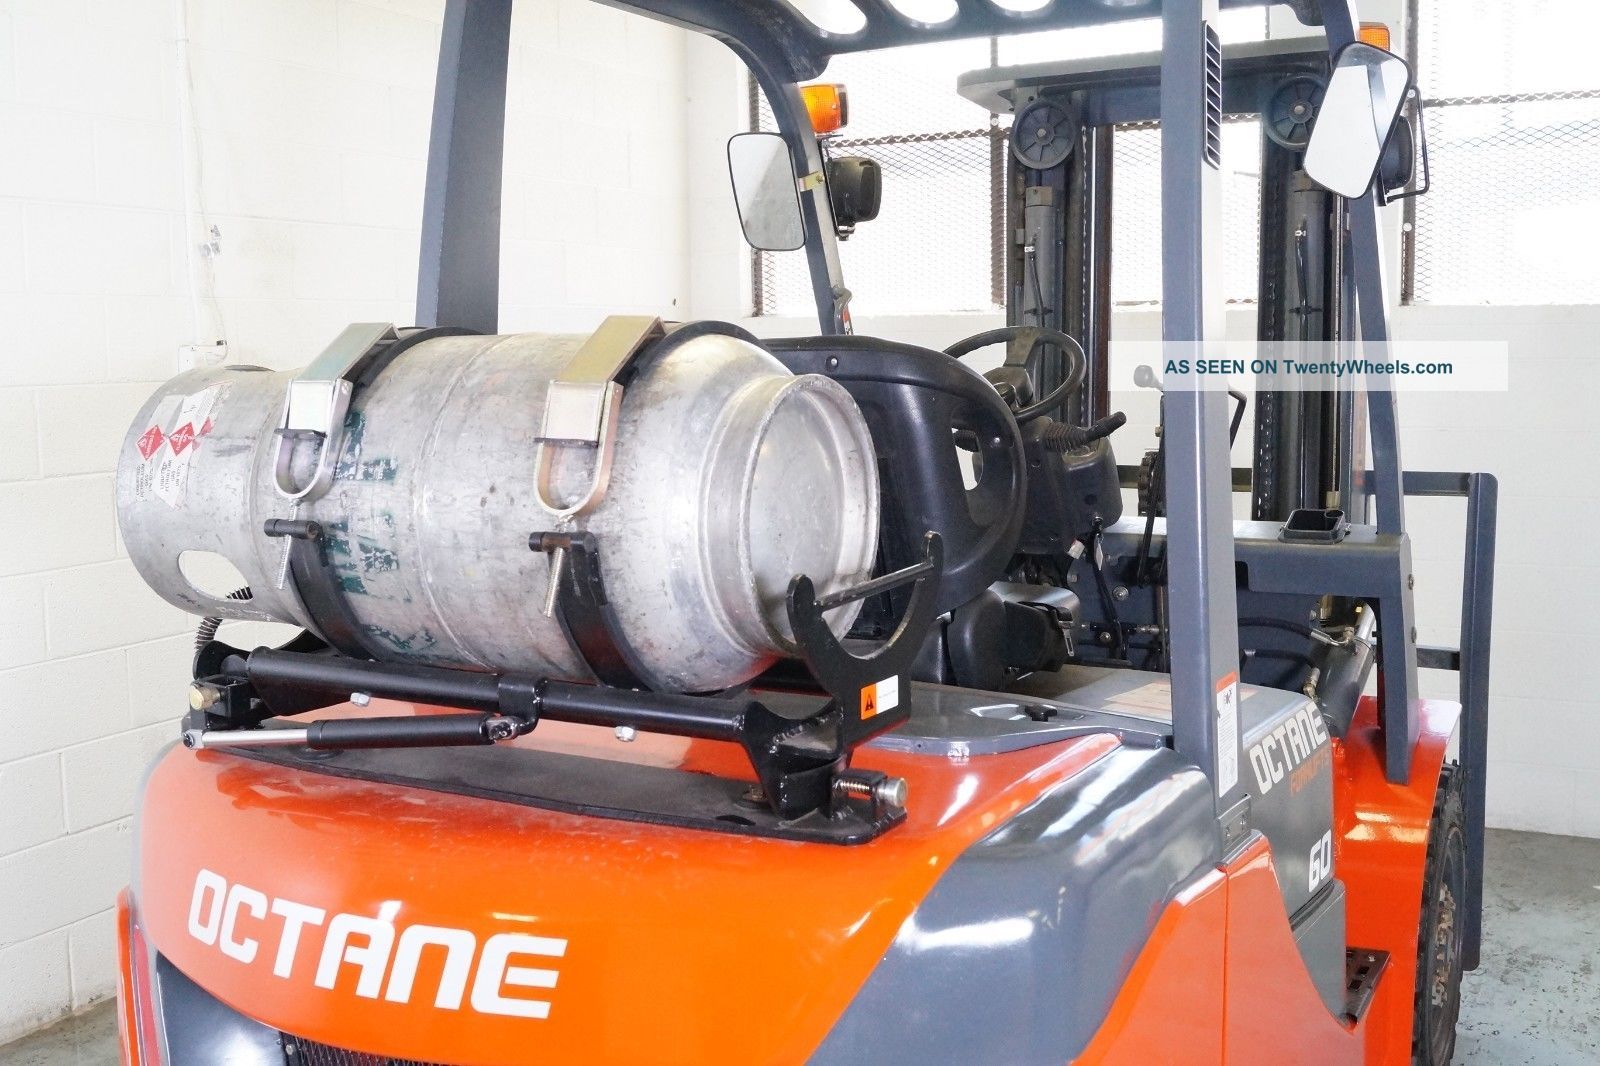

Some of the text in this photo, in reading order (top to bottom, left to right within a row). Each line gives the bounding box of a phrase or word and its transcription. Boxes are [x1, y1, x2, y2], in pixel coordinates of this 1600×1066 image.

[1249, 701, 1327, 795] OCTANE
[1308, 829, 1332, 893] 60
[188, 868, 569, 1019] OCTANE
